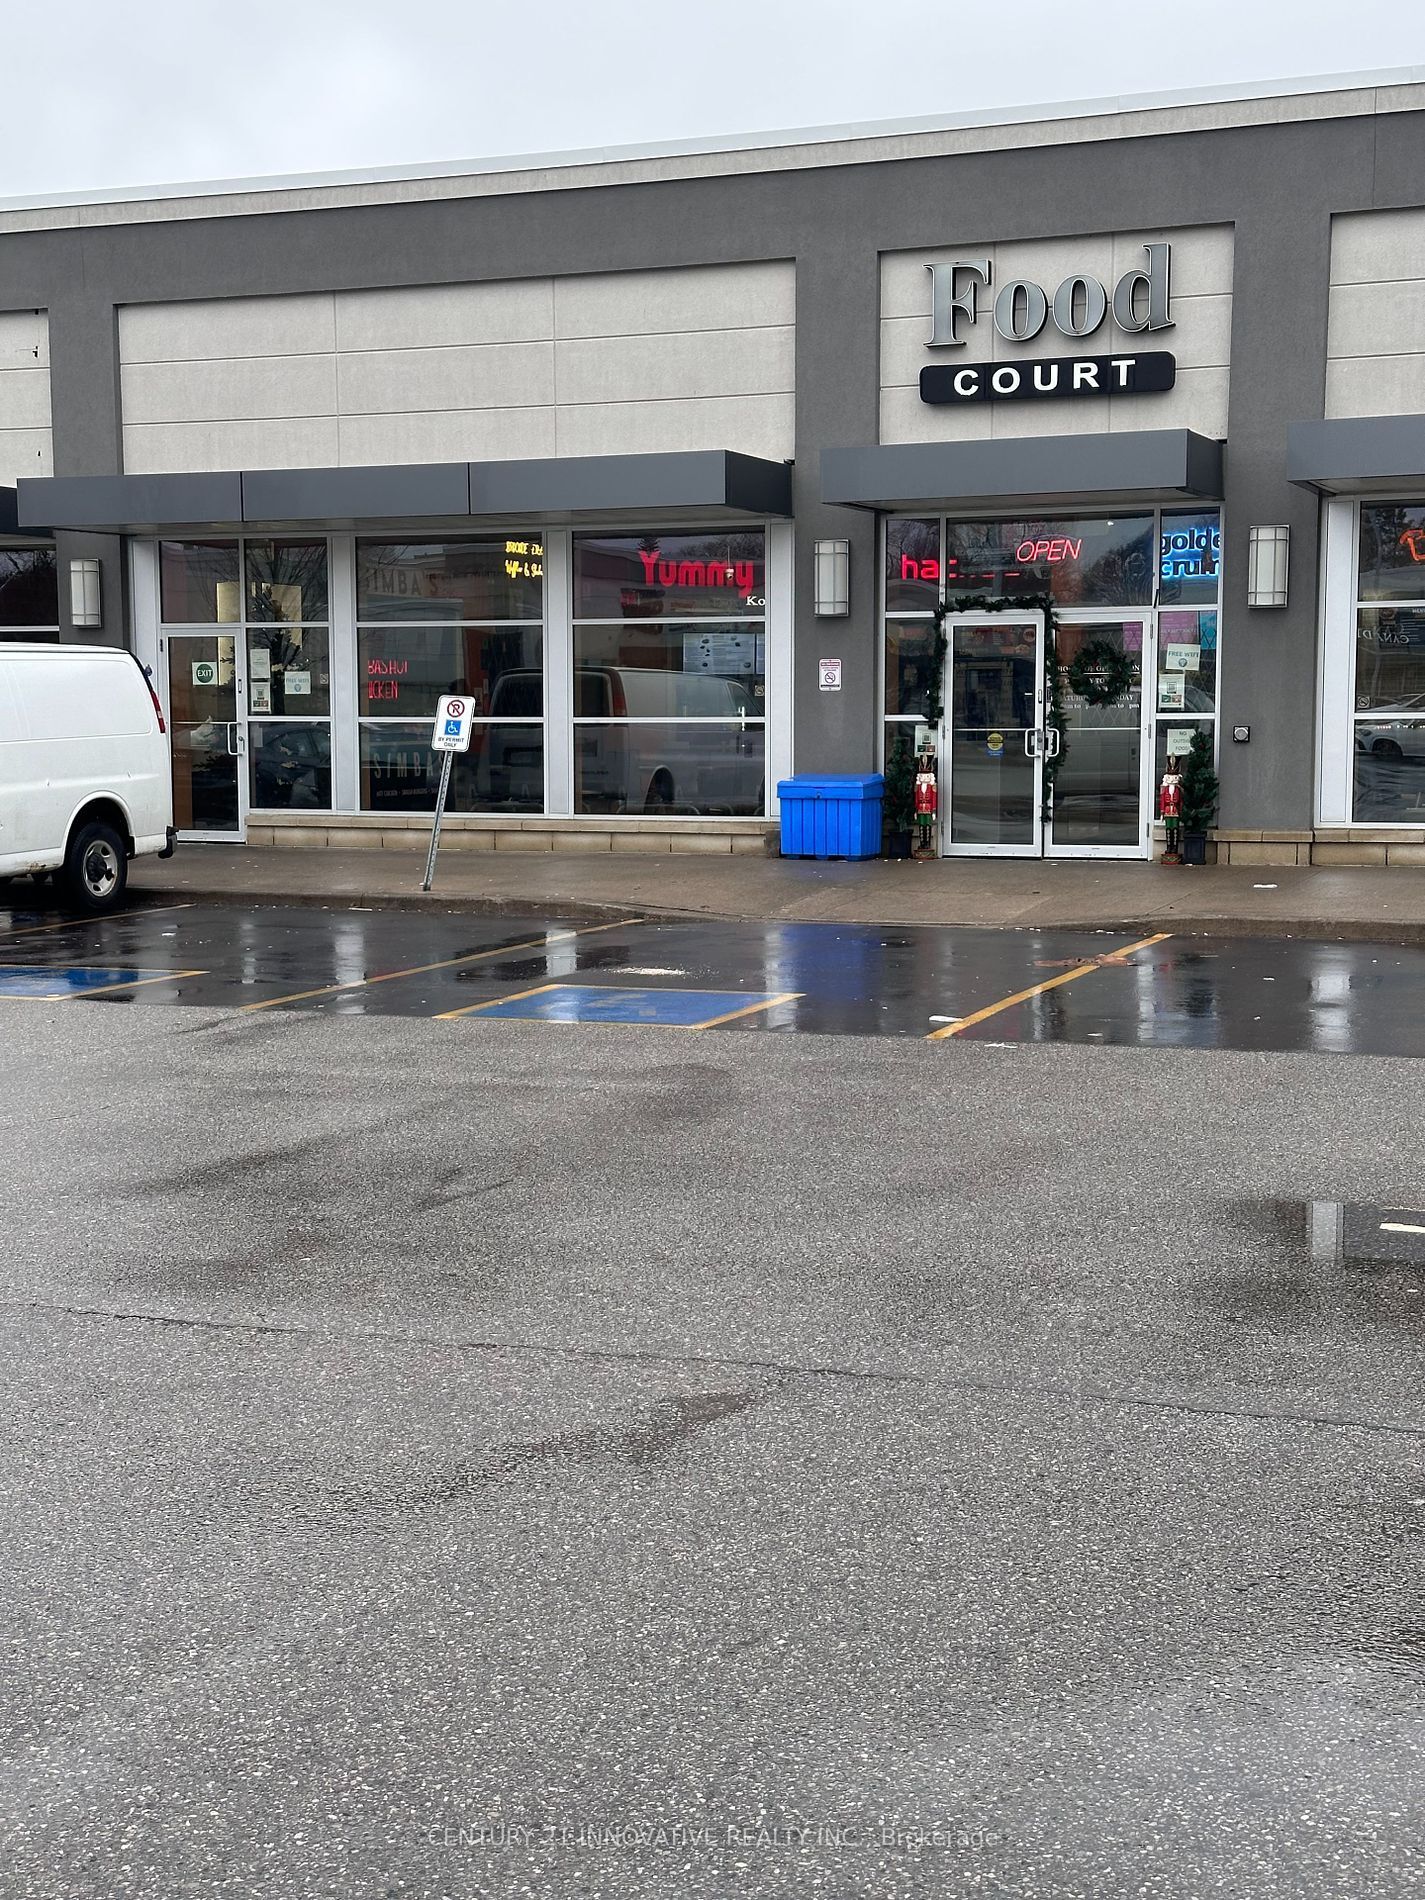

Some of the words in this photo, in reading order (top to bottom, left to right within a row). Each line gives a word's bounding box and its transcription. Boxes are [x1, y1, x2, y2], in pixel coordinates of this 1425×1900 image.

[923, 242, 1176, 347] Food
[953, 360, 1136, 396] COURT
[1016, 539, 1082, 562] OPEN
[638, 550, 754, 598] Yummy
[197, 669, 213, 677] EXIT
